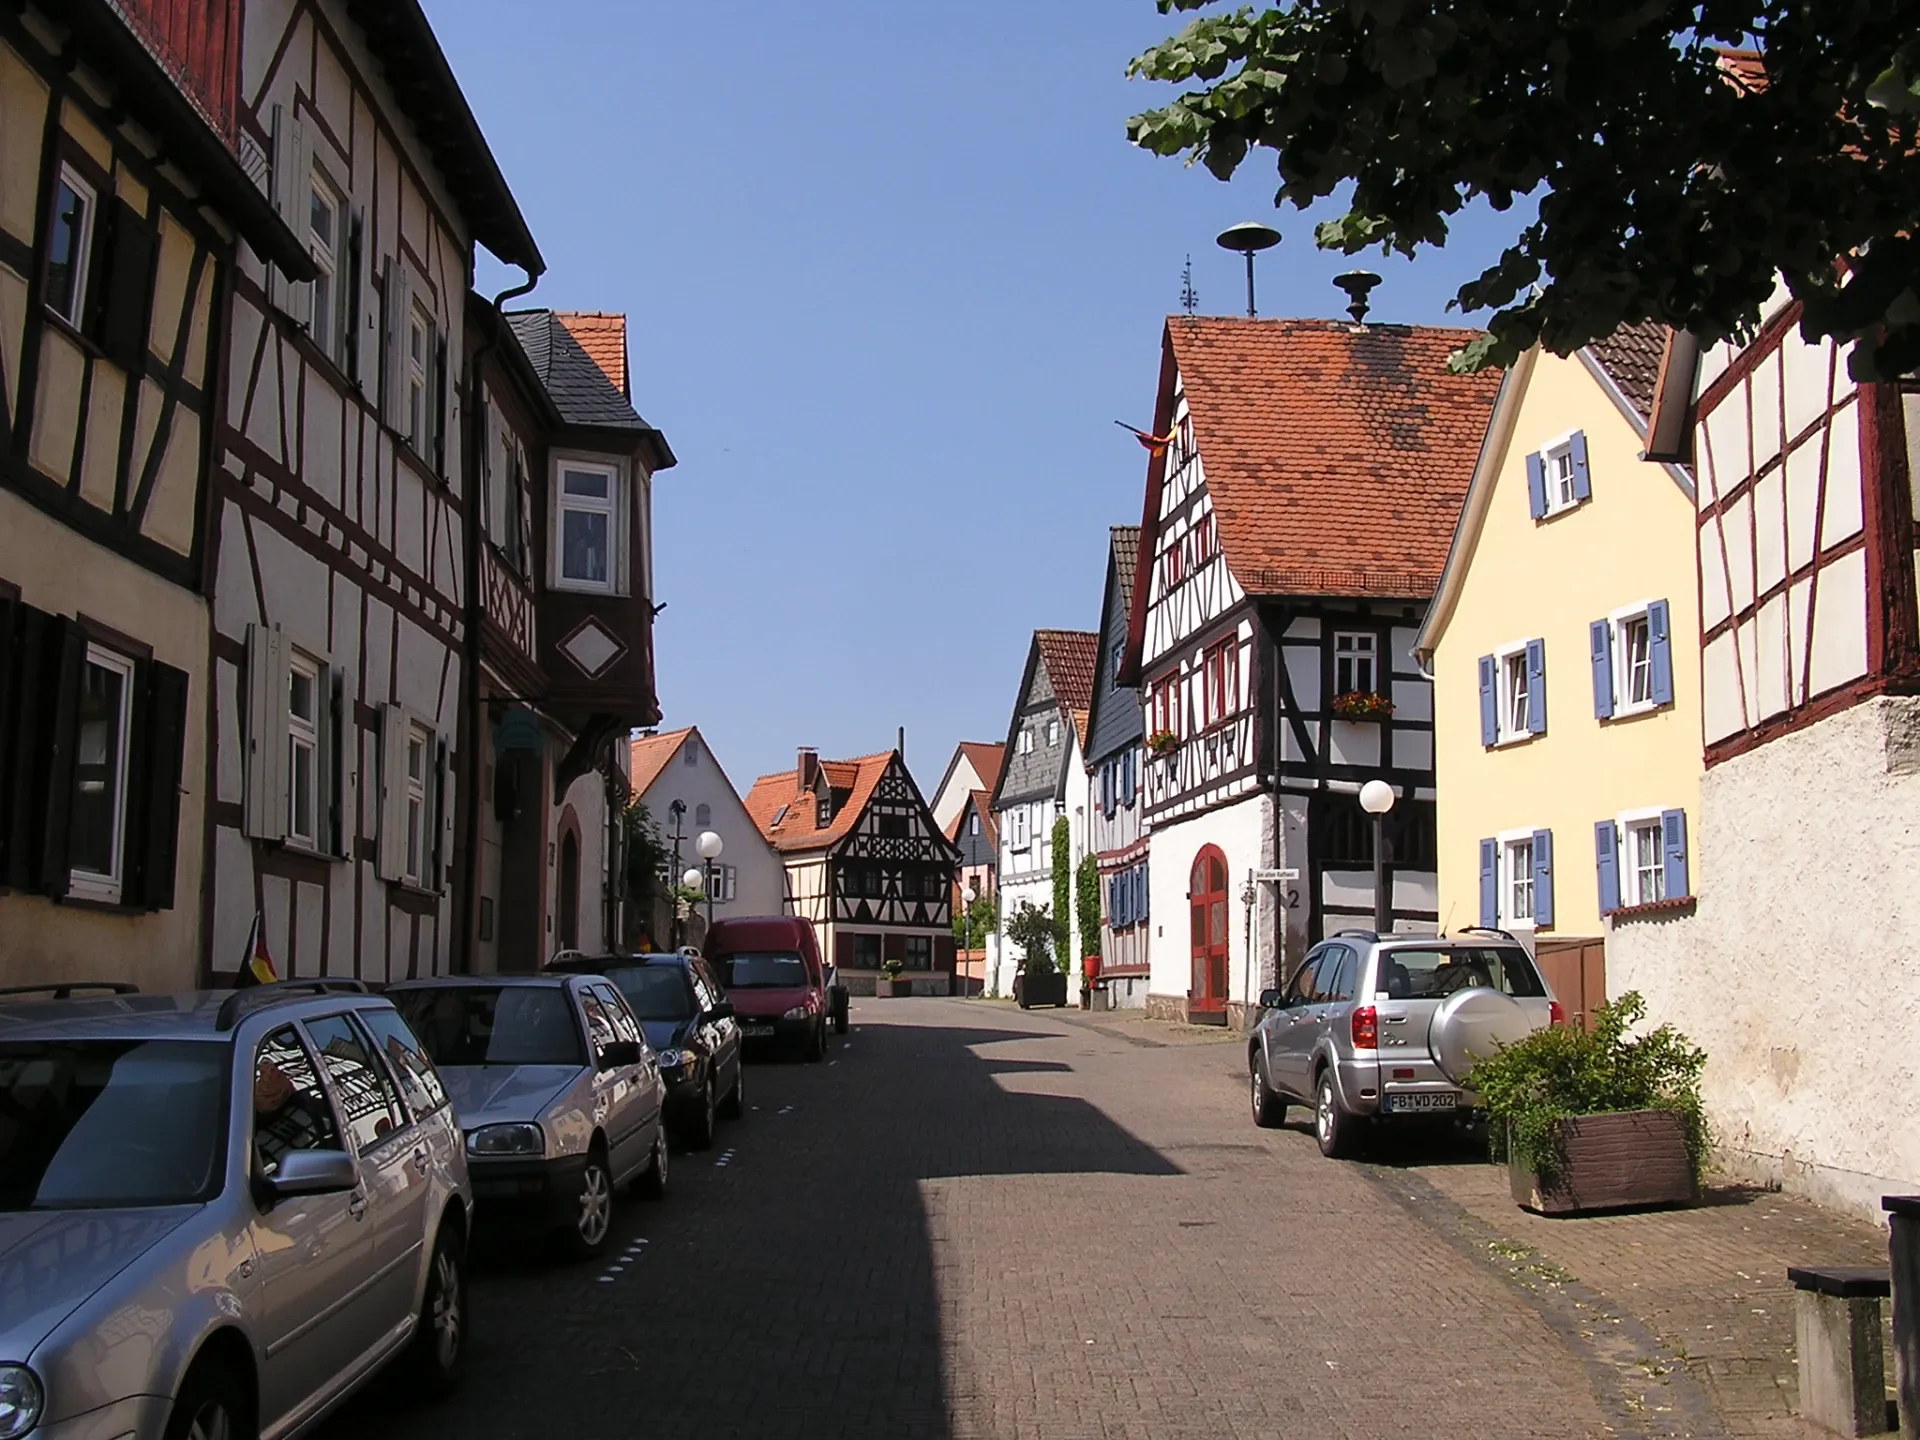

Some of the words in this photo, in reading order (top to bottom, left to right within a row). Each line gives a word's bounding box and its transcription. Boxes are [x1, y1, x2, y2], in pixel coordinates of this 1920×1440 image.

[1288, 889, 1300, 909] 2
[1391, 1095, 1407, 1108] FB
[1414, 1095, 1430, 1107] WD
[1432, 1094, 1454, 1107] 202
